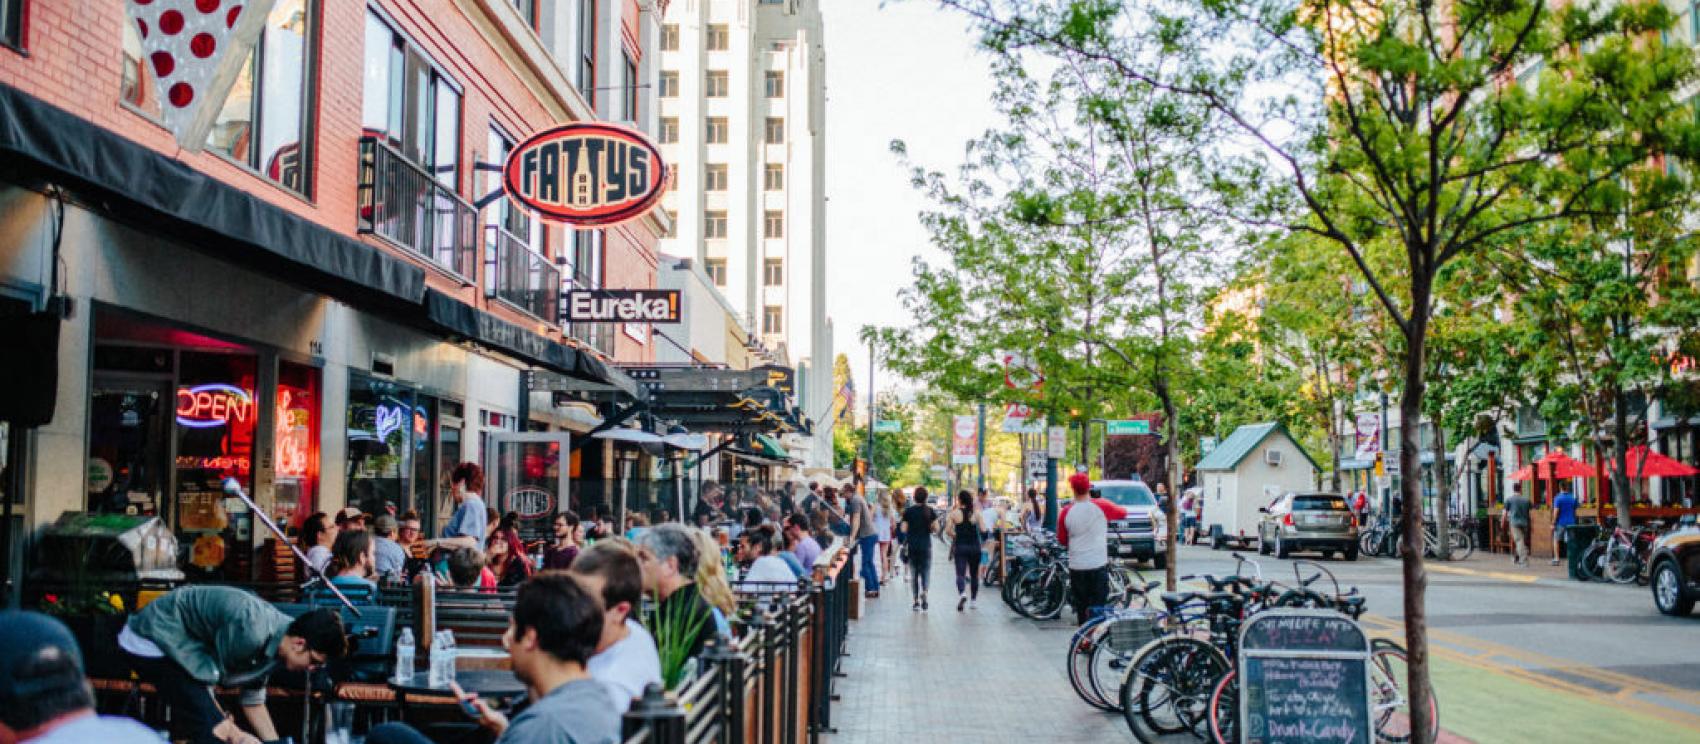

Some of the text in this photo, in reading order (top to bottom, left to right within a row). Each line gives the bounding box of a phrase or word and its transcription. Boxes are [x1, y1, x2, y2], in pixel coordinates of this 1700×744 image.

[523, 138, 648, 204] FATTYS
[571, 292, 677, 319] Eureka!
[176, 389, 246, 422] OPEN
